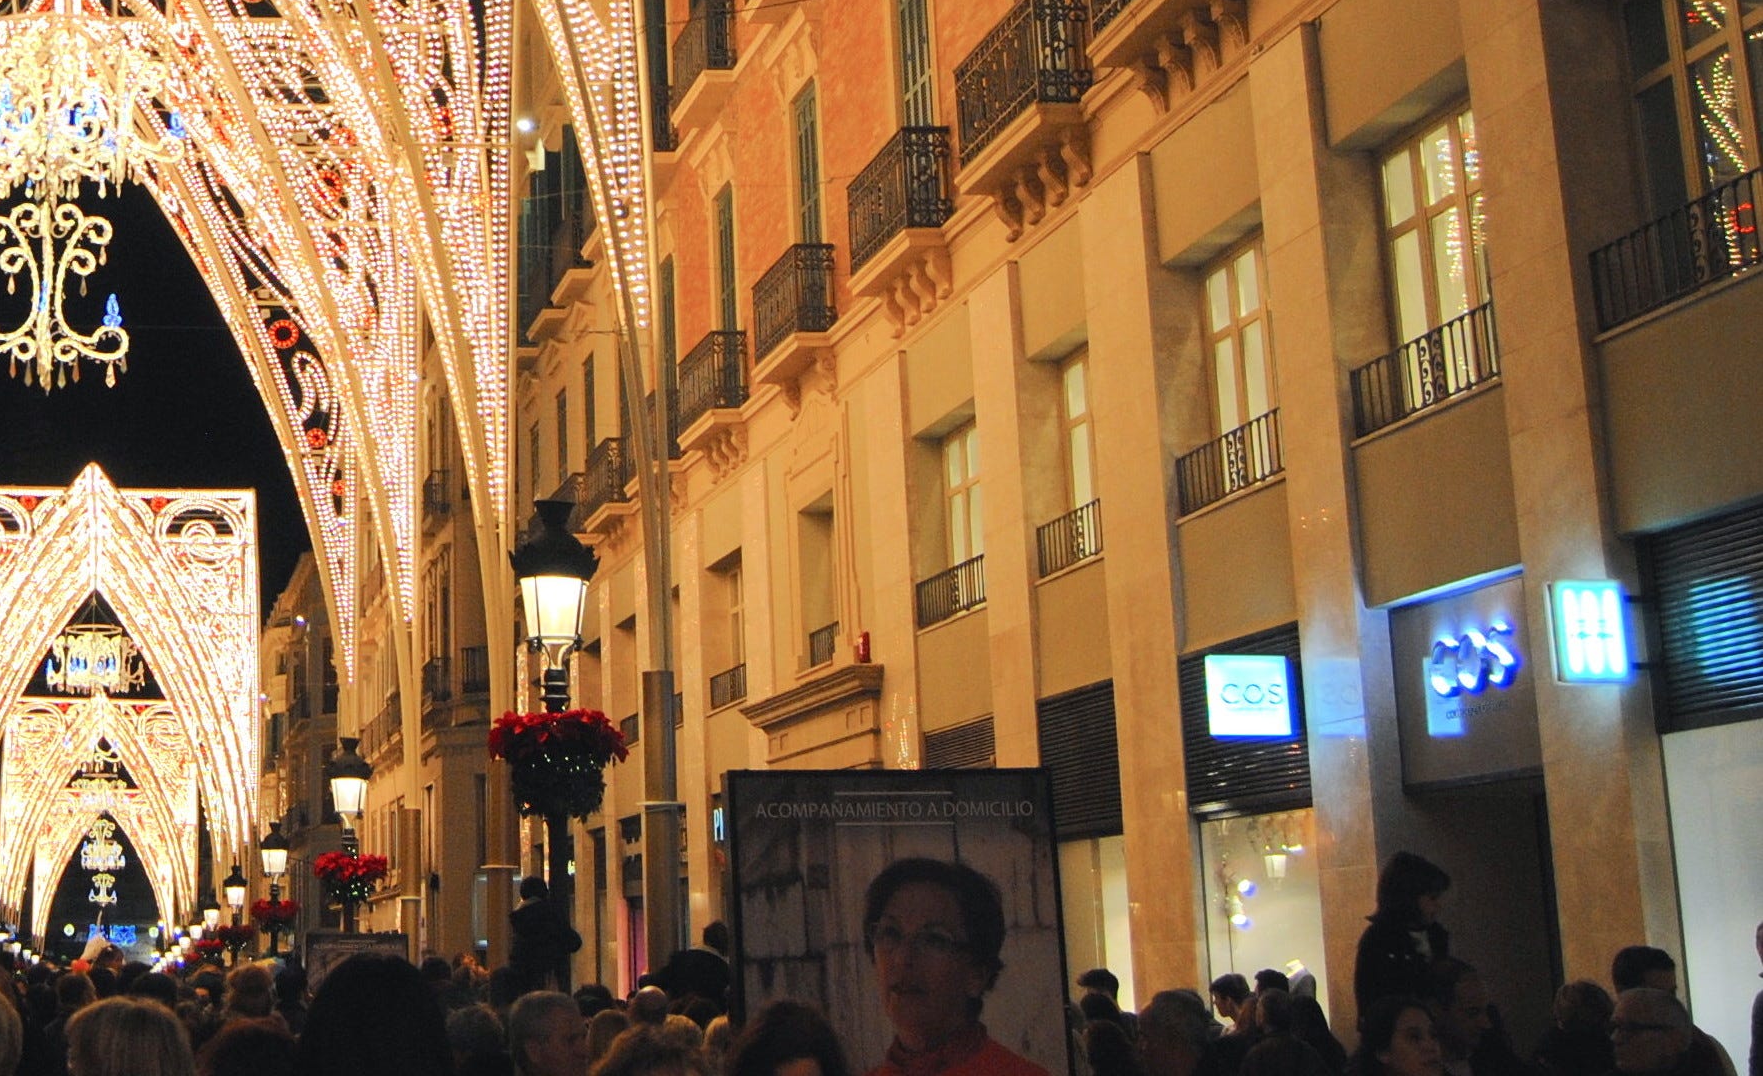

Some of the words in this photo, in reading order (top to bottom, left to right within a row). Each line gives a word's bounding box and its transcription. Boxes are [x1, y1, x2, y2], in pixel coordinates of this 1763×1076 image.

[1430, 621, 1519, 698] COS
[1220, 683, 1283, 705] COS
[755, 799, 922, 818] ACOMPAÑAMIENTO
[927, 802, 938, 816] A
[942, 800, 1034, 816] DOMICILIO
